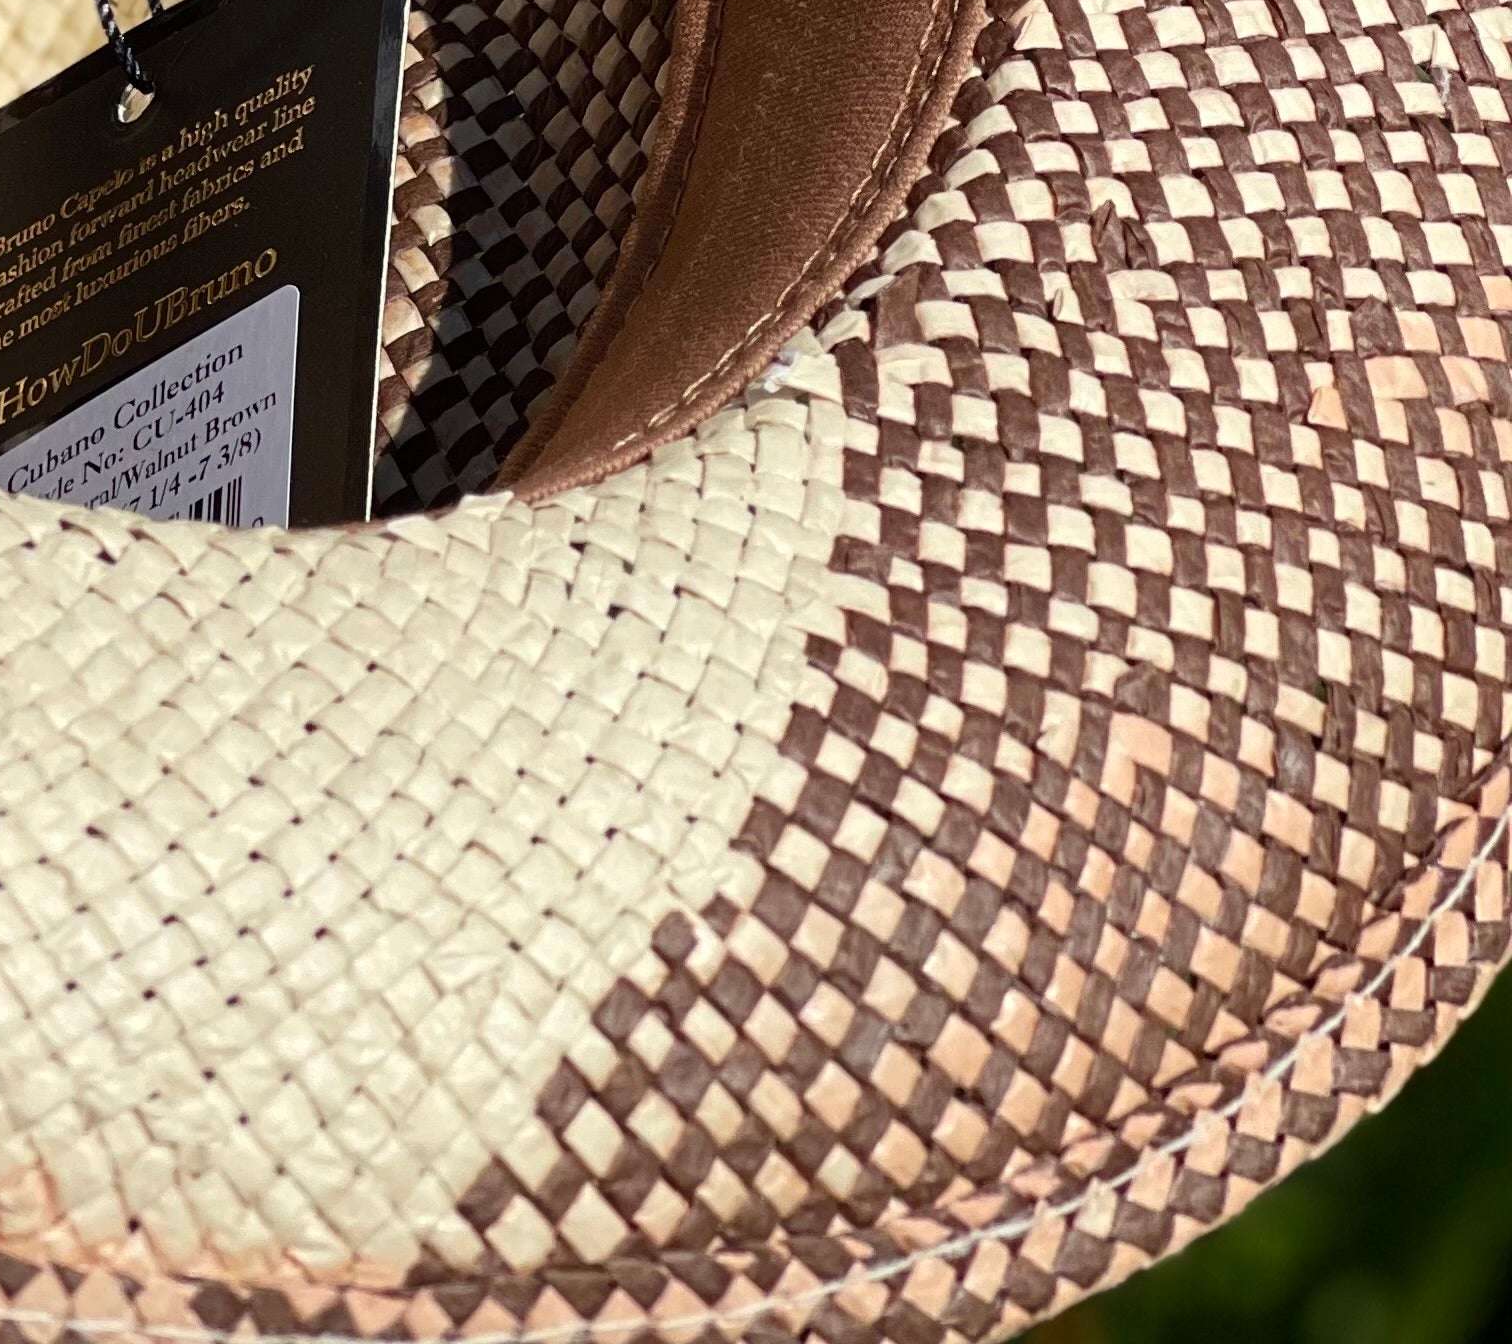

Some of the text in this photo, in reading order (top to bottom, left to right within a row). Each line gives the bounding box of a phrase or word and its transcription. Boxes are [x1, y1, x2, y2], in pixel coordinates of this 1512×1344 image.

[60, 168, 135, 219] Capelo
[140, 153, 157, 175] is
[161, 144, 175, 162] a
[178, 107, 229, 154] high
[235, 64, 316, 126] quality
[60, 240, 113, 283] from
[117, 199, 178, 250] finest
[181, 159, 255, 214] fabrics
[259, 126, 304, 169] and
[68, 178, 154, 248] forward
[159, 121, 268, 196] headwear
[272, 96, 317, 133] line
[18, 293, 71, 337] most
[75, 233, 178, 306] luxurious
[181, 196, 251, 245] fibers.
[7, 343, 244, 495] Cubano Collection
[39, 381, 225, 500] yle No: CU-404
[84, 392, 277, 510] ral/Walnut Brown
[149, 471, 180, 510] 1/4
[218, 427, 261, 469] 3/8)
